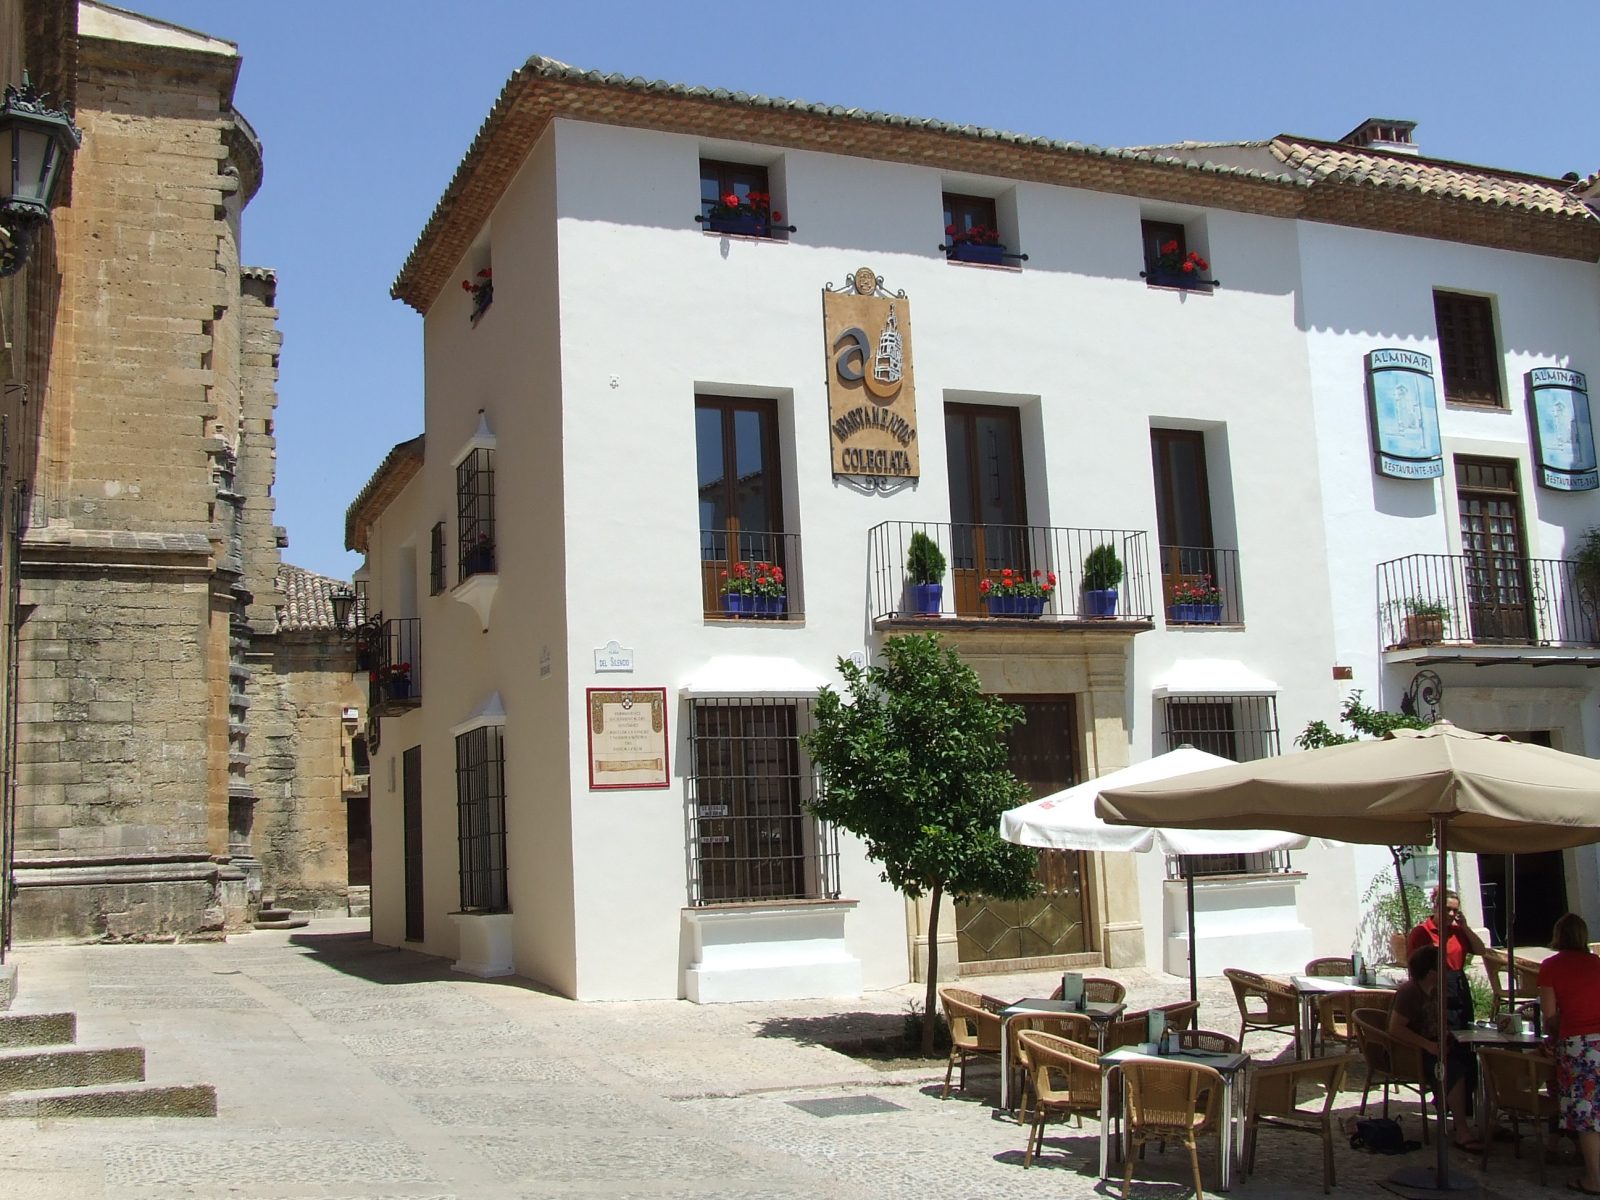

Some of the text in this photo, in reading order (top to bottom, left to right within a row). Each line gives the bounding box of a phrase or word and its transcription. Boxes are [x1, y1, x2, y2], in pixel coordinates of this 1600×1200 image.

[1374, 351, 1429, 368] ALMINAR
[1533, 371, 1583, 386] ALMINAR
[842, 449, 911, 474] COLEGIATA
[599, 659, 608, 667] DEL
